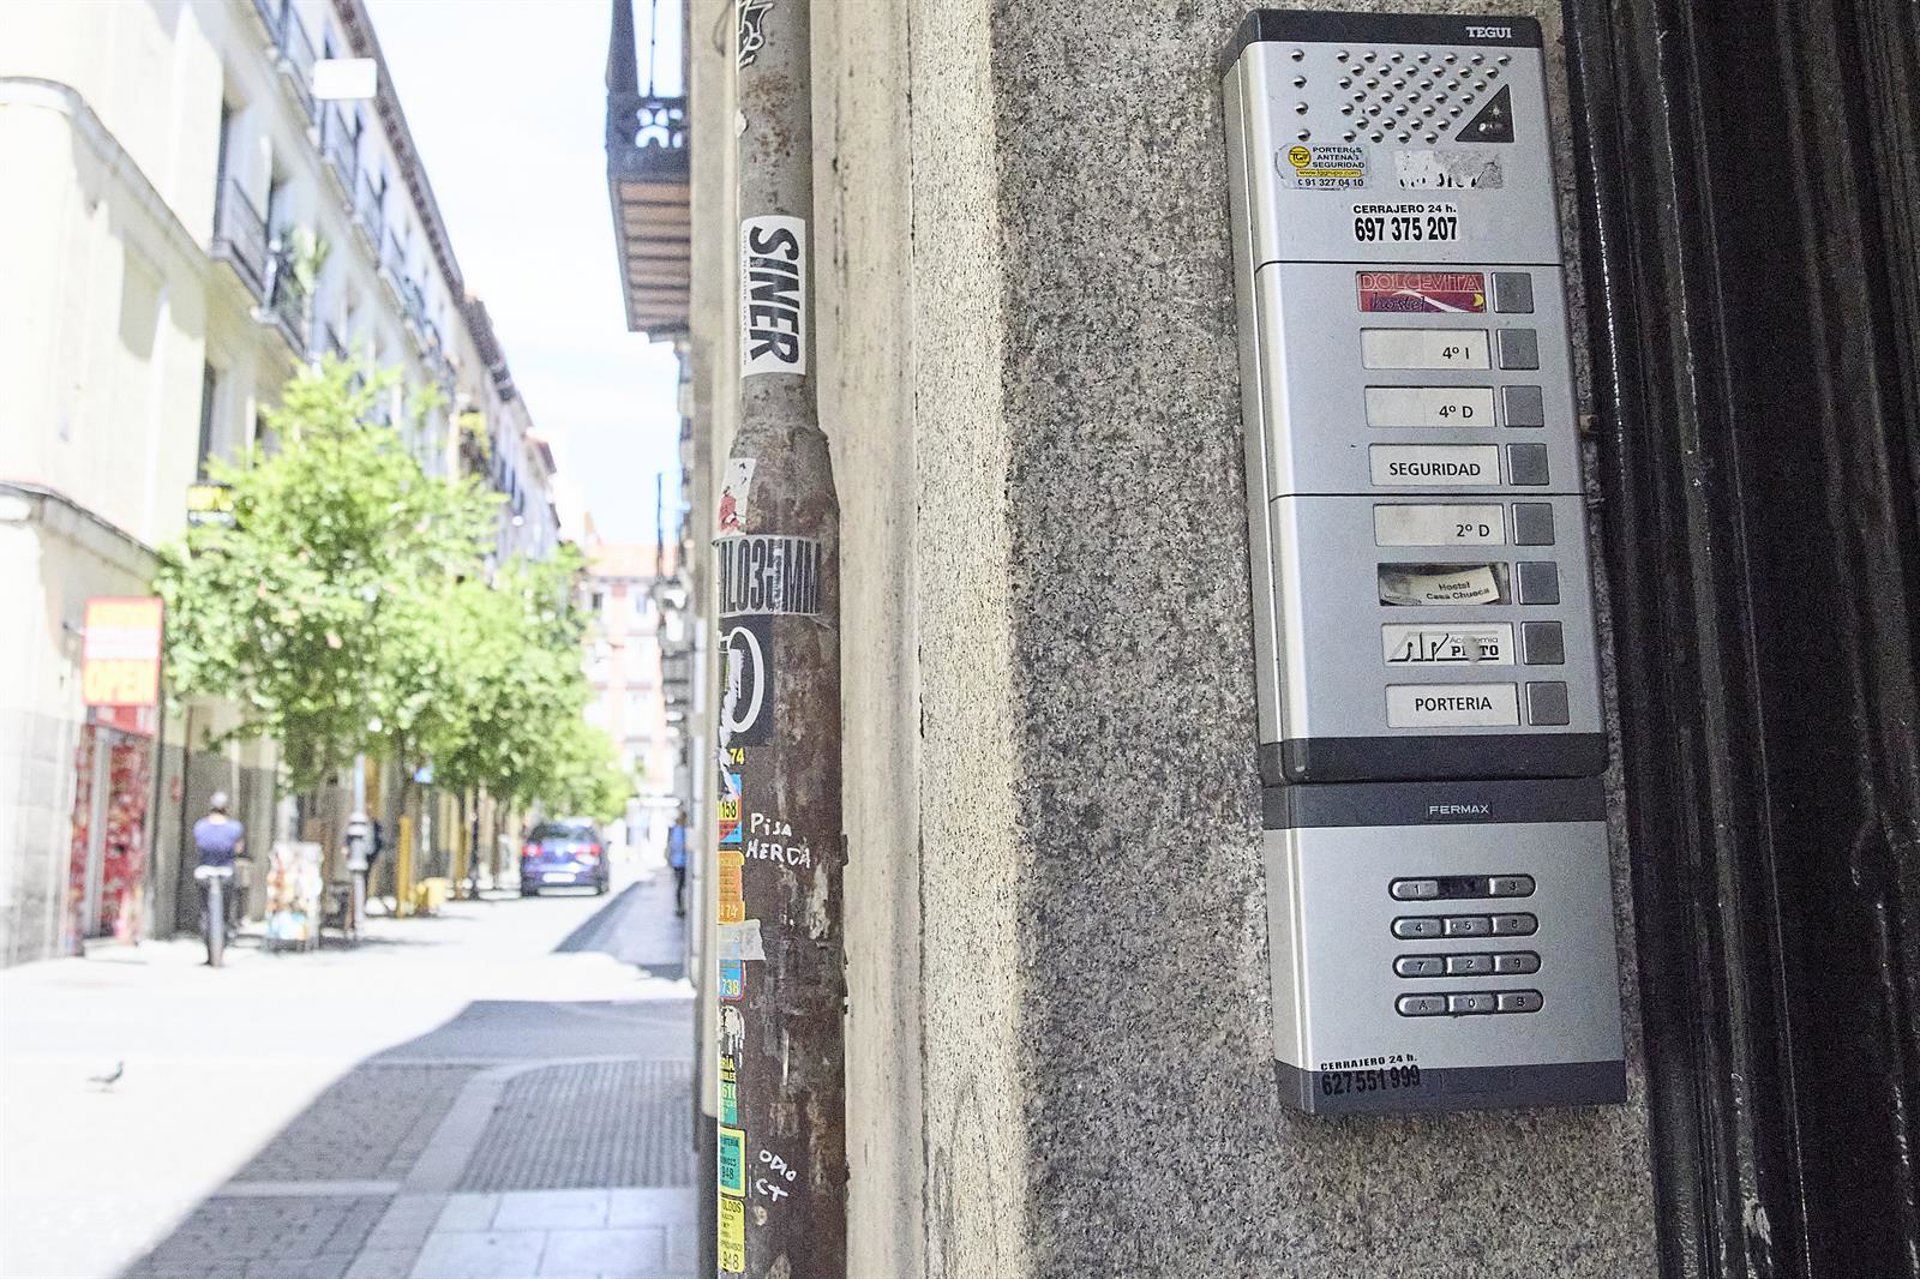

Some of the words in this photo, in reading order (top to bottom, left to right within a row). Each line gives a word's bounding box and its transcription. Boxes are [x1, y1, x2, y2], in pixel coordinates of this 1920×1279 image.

[1466, 26, 1512, 39] TEGUI
[1312, 161, 1365, 169] SEGURIDAD
[1305, 179, 1316, 187] 91
[1319, 179, 1337, 187] 327
[1353, 179, 1364, 187] 10
[1353, 204, 1425, 214] CERRAJERO
[1427, 204, 1442, 213] 24
[1445, 204, 1457, 213] h.
[1354, 216, 1385, 242] 697
[1391, 216, 1423, 241] 375
[1427, 216, 1457, 241] 207
[1361, 274, 1482, 291] DOLCEVITA
[749, 226, 800, 365] SINER
[1462, 405, 1474, 418] D
[1389, 462, 1481, 476] SEGURIDAD
[1479, 524, 1490, 537] D
[1415, 697, 1493, 712] PORTERIA
[1429, 804, 1490, 815] FERMAX
[1508, 880, 1518, 891] 3
[1415, 923, 1423, 933] 4
[1417, 961, 1426, 972] 7
[1466, 959, 1475, 969] 2
[1320, 1056, 1386, 1071] CERRAJERO
[1388, 1054, 1403, 1064] 24
[1321, 1072, 1352, 1096] 627
[1355, 1068, 1387, 1092] 551
[1390, 1064, 1420, 1089] 999
